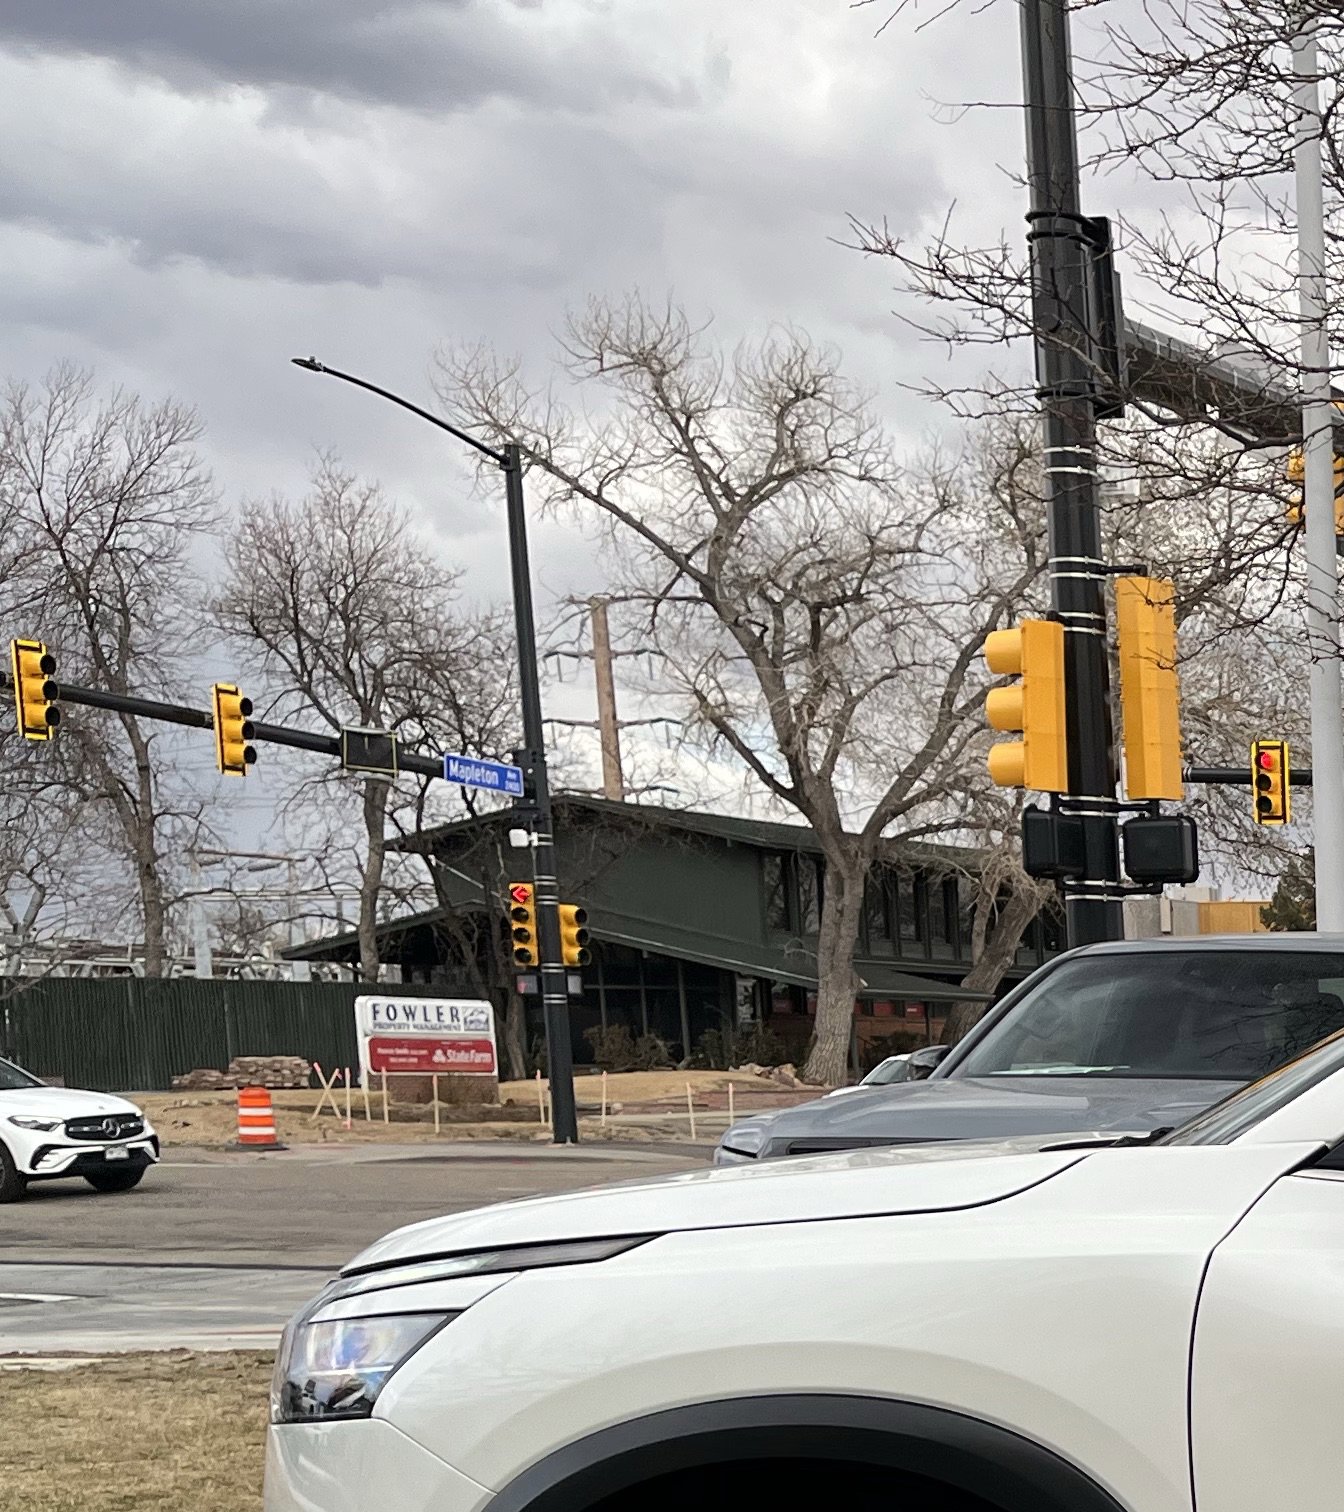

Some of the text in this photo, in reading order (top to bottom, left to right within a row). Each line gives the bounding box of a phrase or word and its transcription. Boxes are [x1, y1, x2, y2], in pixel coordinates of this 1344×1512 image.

[448, 759, 499, 787] Mapleton
[371, 1003, 461, 1023] FOWLER
[373, 1022, 461, 1032] PROPERTY MANAGEMENT
